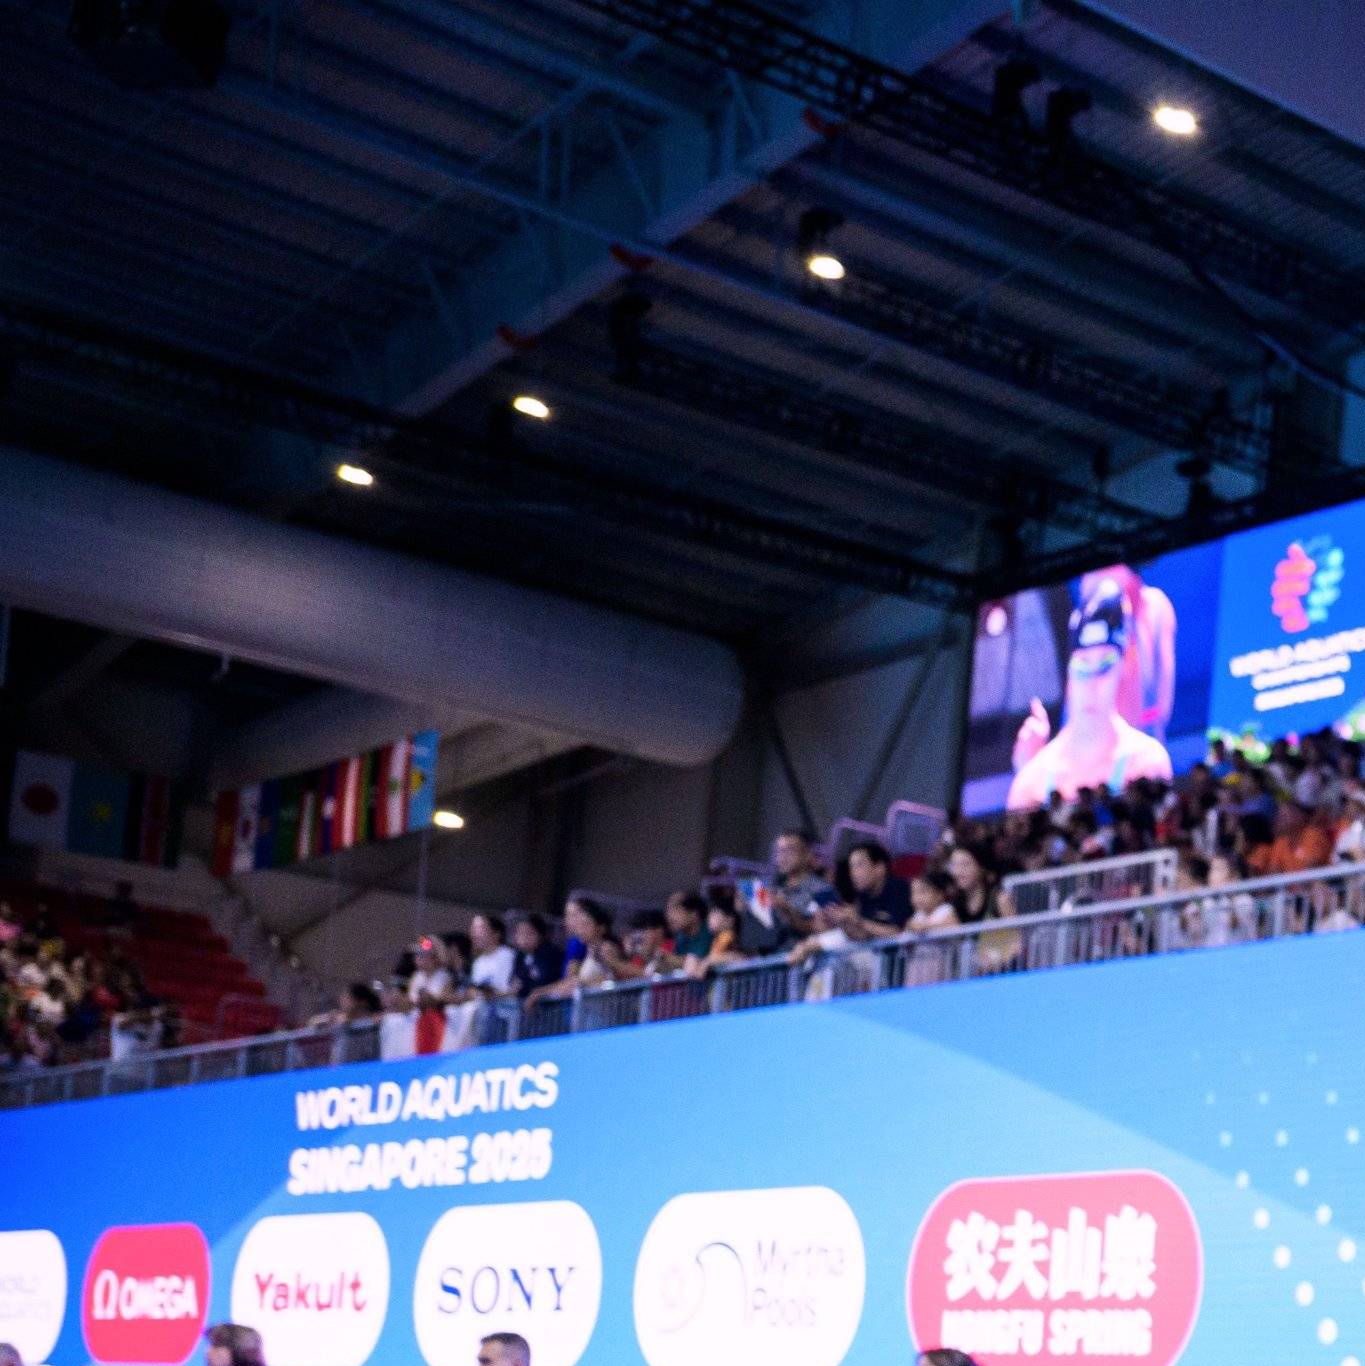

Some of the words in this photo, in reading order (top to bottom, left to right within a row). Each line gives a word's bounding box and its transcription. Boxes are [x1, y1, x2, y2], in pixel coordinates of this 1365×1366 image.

[296, 1081, 403, 1132] WORLD
[403, 1061, 559, 1117] AQUATICS
[287, 1137, 467, 1195] SINGAPORE
[468, 1127, 553, 1185] 2025
[119, 1276, 198, 1320] OMEGA
[255, 1271, 368, 1313] Yakult
[438, 1265, 578, 1315] SONY
